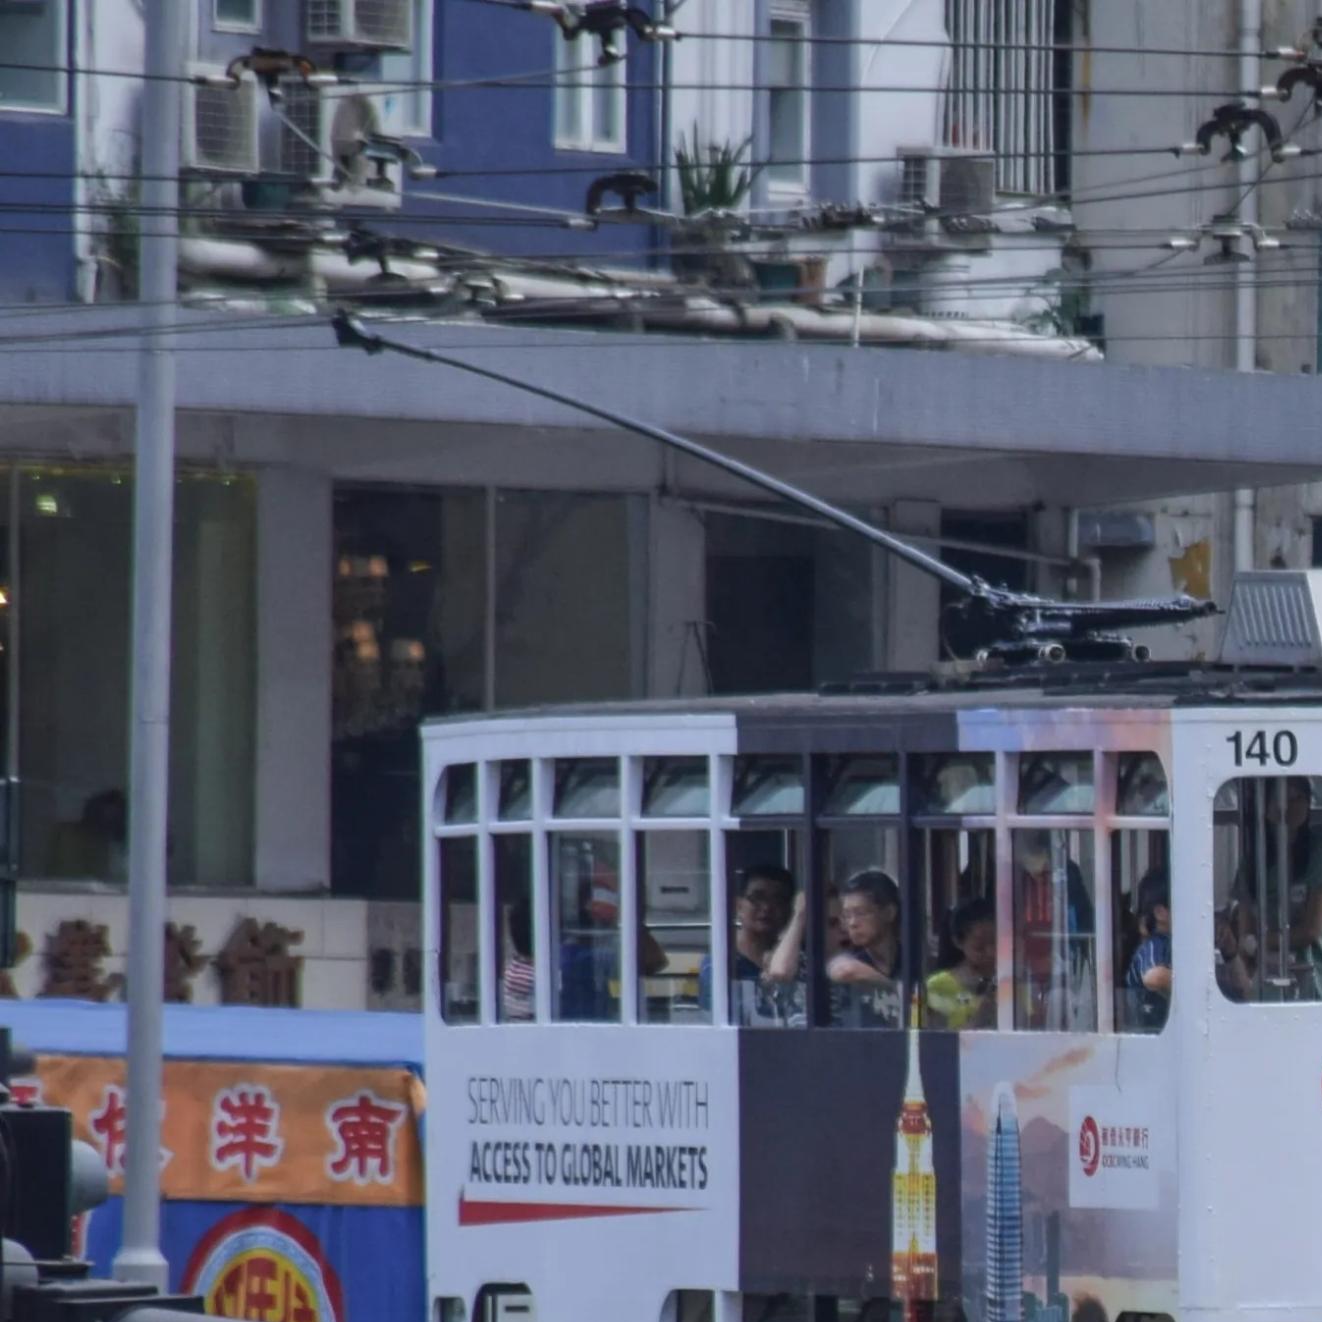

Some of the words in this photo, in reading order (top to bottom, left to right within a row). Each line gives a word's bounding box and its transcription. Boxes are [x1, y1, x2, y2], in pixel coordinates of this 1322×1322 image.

[1226, 730, 1298, 767] 140
[467, 1077, 545, 1126] SERVING
[550, 1078, 585, 1127] YOU
[590, 1079, 652, 1128] BETTER
[657, 1081, 709, 1129] WITH
[470, 1141, 531, 1184] ACCESS
[535, 1143, 557, 1185] TO
[561, 1144, 622, 1187] GLOBAL
[626, 1144, 708, 1190] MARKETS
